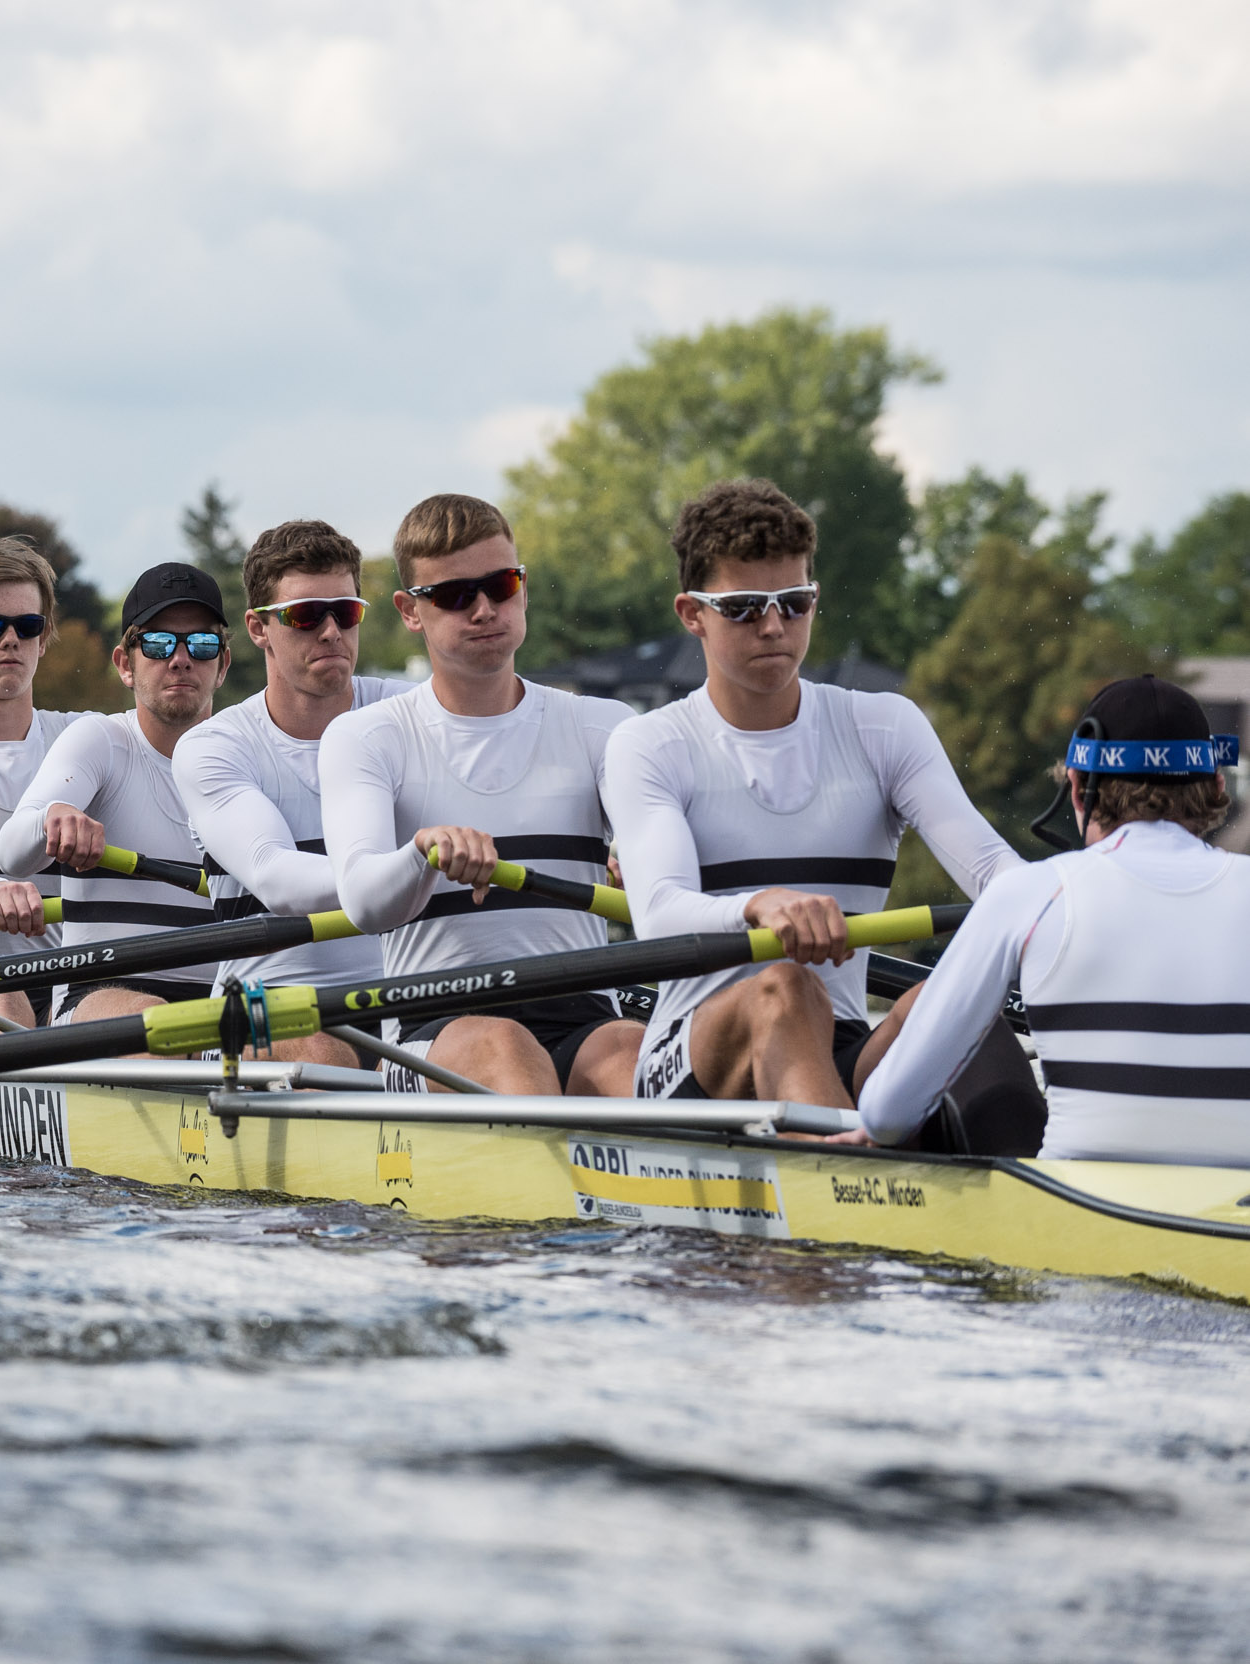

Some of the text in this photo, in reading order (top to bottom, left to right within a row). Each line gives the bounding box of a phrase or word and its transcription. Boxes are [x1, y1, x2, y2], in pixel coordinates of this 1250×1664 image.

[1073, 744, 1090, 765] NK
[1099, 747, 1126, 767] NK
[1143, 747, 1170, 767] NK
[1185, 746, 1203, 766] NK
[3, 948, 115, 978] concept 2
[386, 970, 517, 1003] concept 2
[637, 995, 652, 1009] 2
[886, 1177, 926, 1208] Minden
